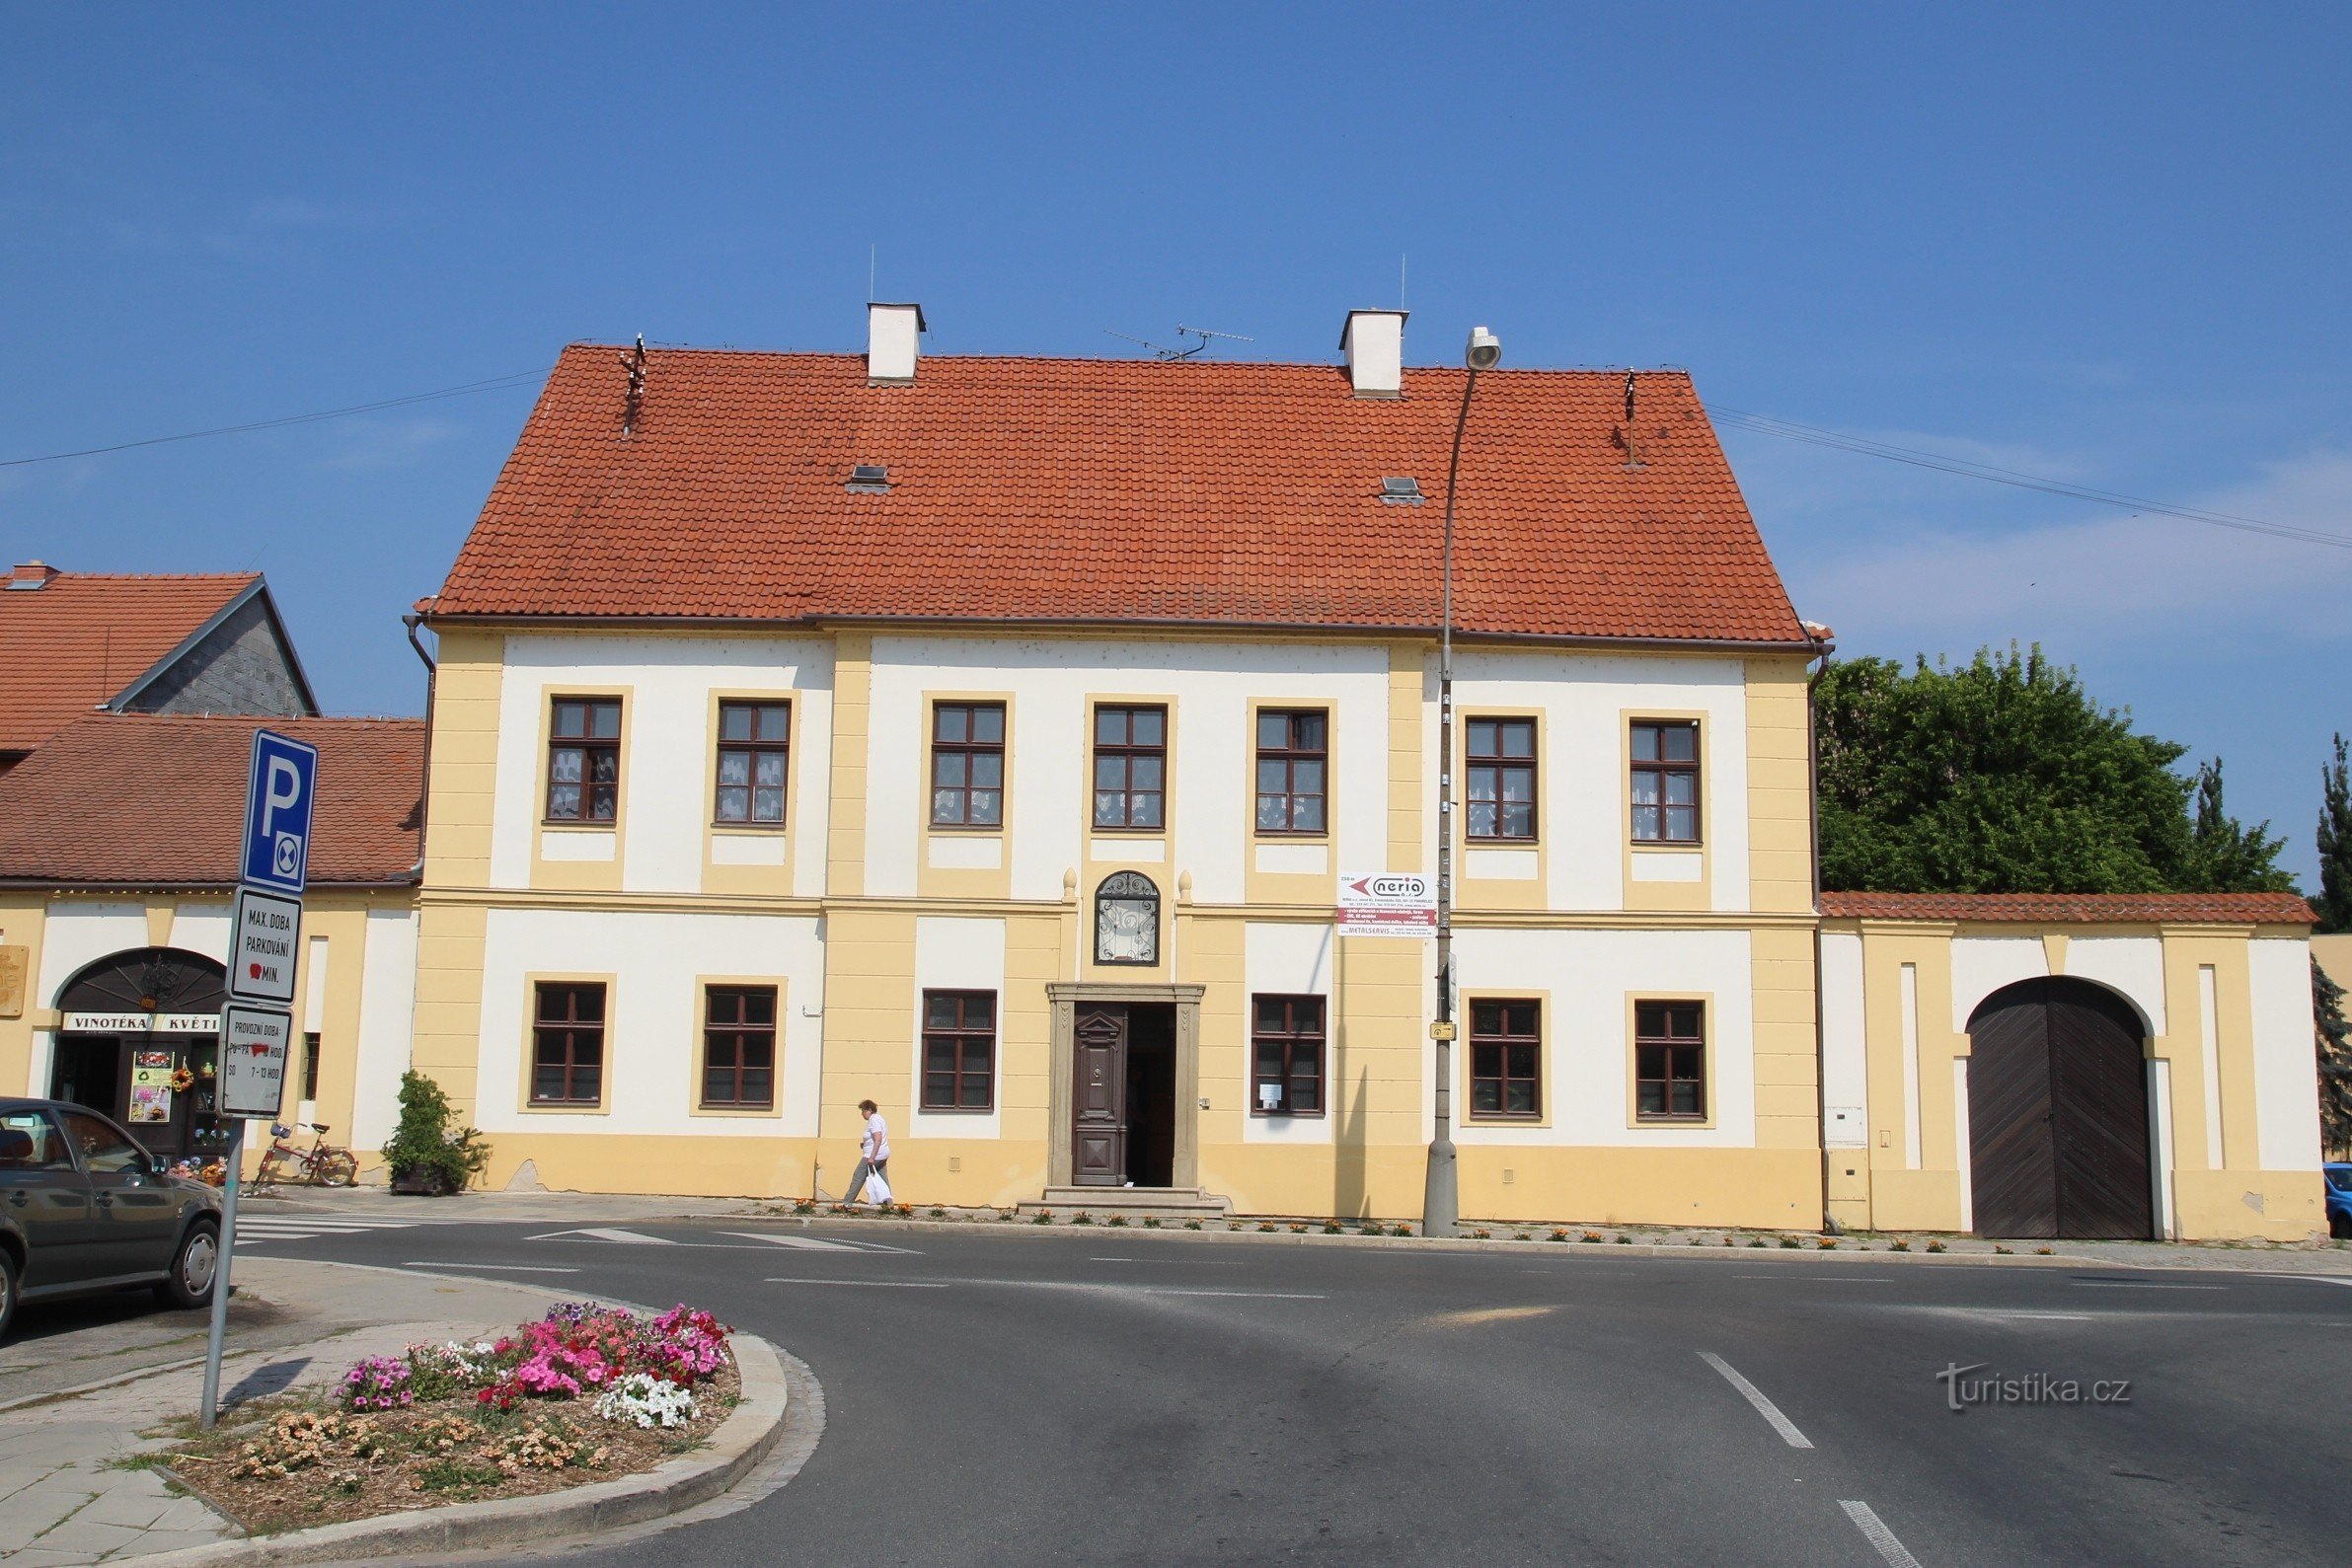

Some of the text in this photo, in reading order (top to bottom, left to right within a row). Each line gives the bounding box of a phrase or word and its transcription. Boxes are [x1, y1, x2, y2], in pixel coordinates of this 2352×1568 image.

[262, 754, 301, 837] P
[1377, 877, 1420, 892] neria
[248, 909, 290, 931] MAX. DOBA
[246, 936, 289, 957] PARKOVÁNÍ
[262, 965, 278, 983] MIN.
[75, 1015, 147, 1028] VINOTÉKA
[235, 1021, 281, 1037] PROVOZNÍ DOBA:
[269, 1047, 283, 1059] HOD.
[228, 1065, 236, 1076] SO
[252, 1067, 256, 1078] 7
[261, 1068, 267, 1078] 13
[266, 1069, 281, 1080] HOD.
